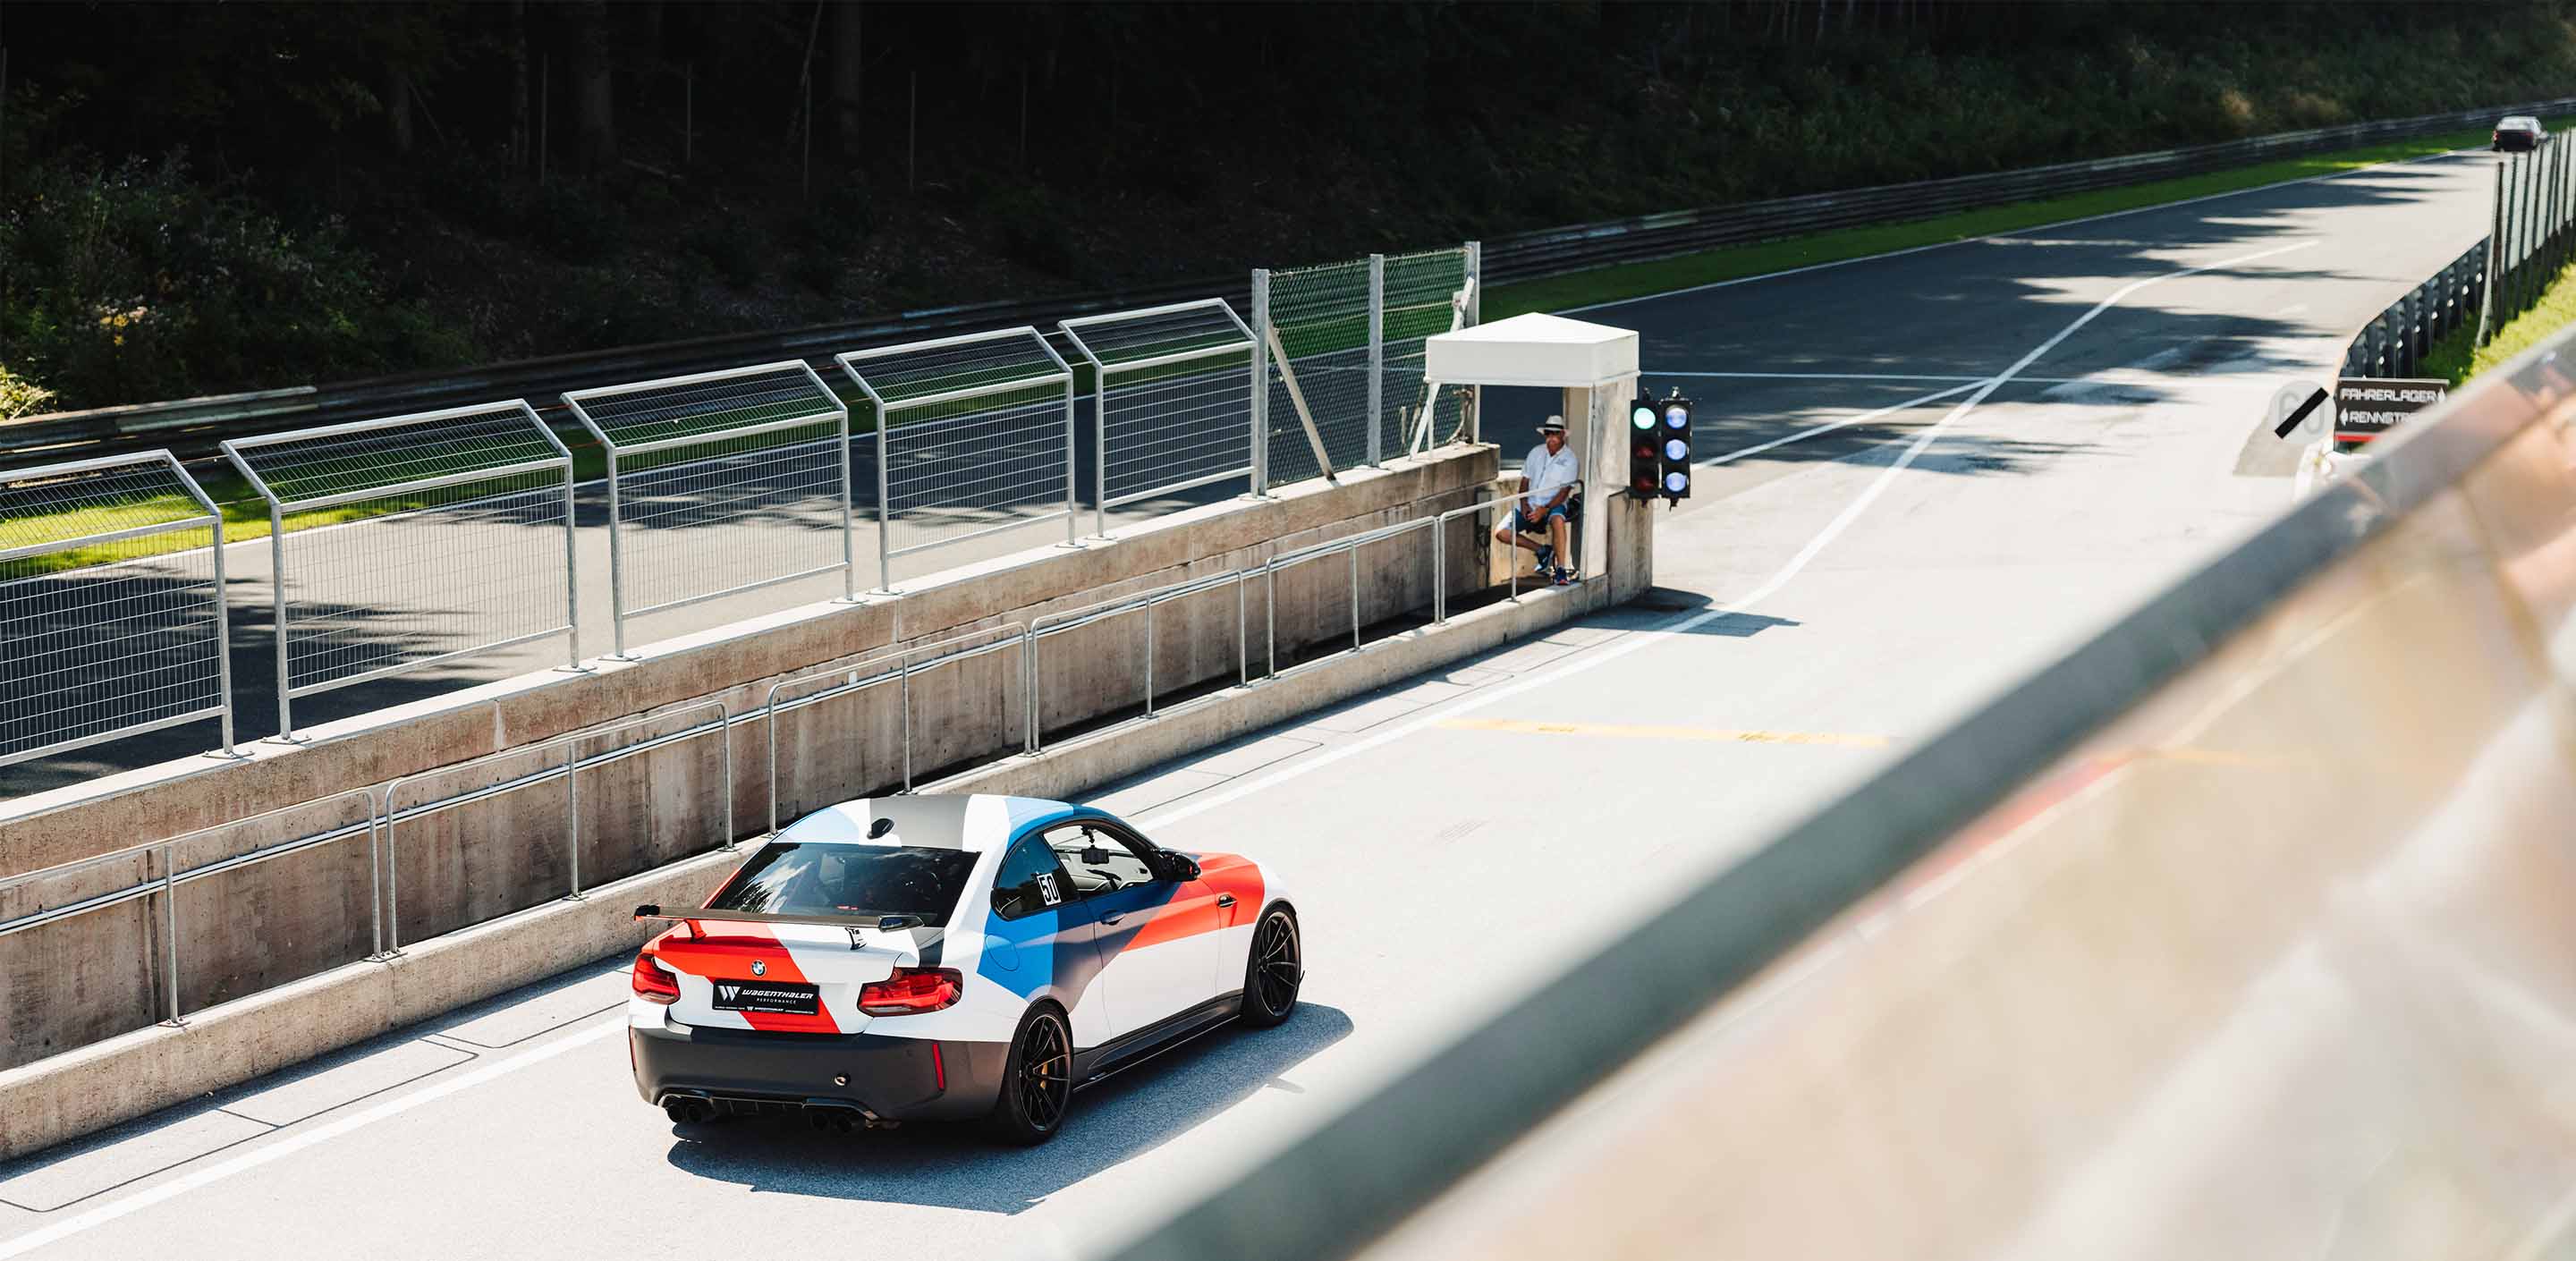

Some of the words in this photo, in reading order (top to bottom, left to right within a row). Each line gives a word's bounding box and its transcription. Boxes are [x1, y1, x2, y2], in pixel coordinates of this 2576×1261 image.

[2340, 388, 2437, 402] FAHRERLAGER
[1038, 876, 1059, 902] 50
[741, 989, 814, 999] WAGENTHALER
